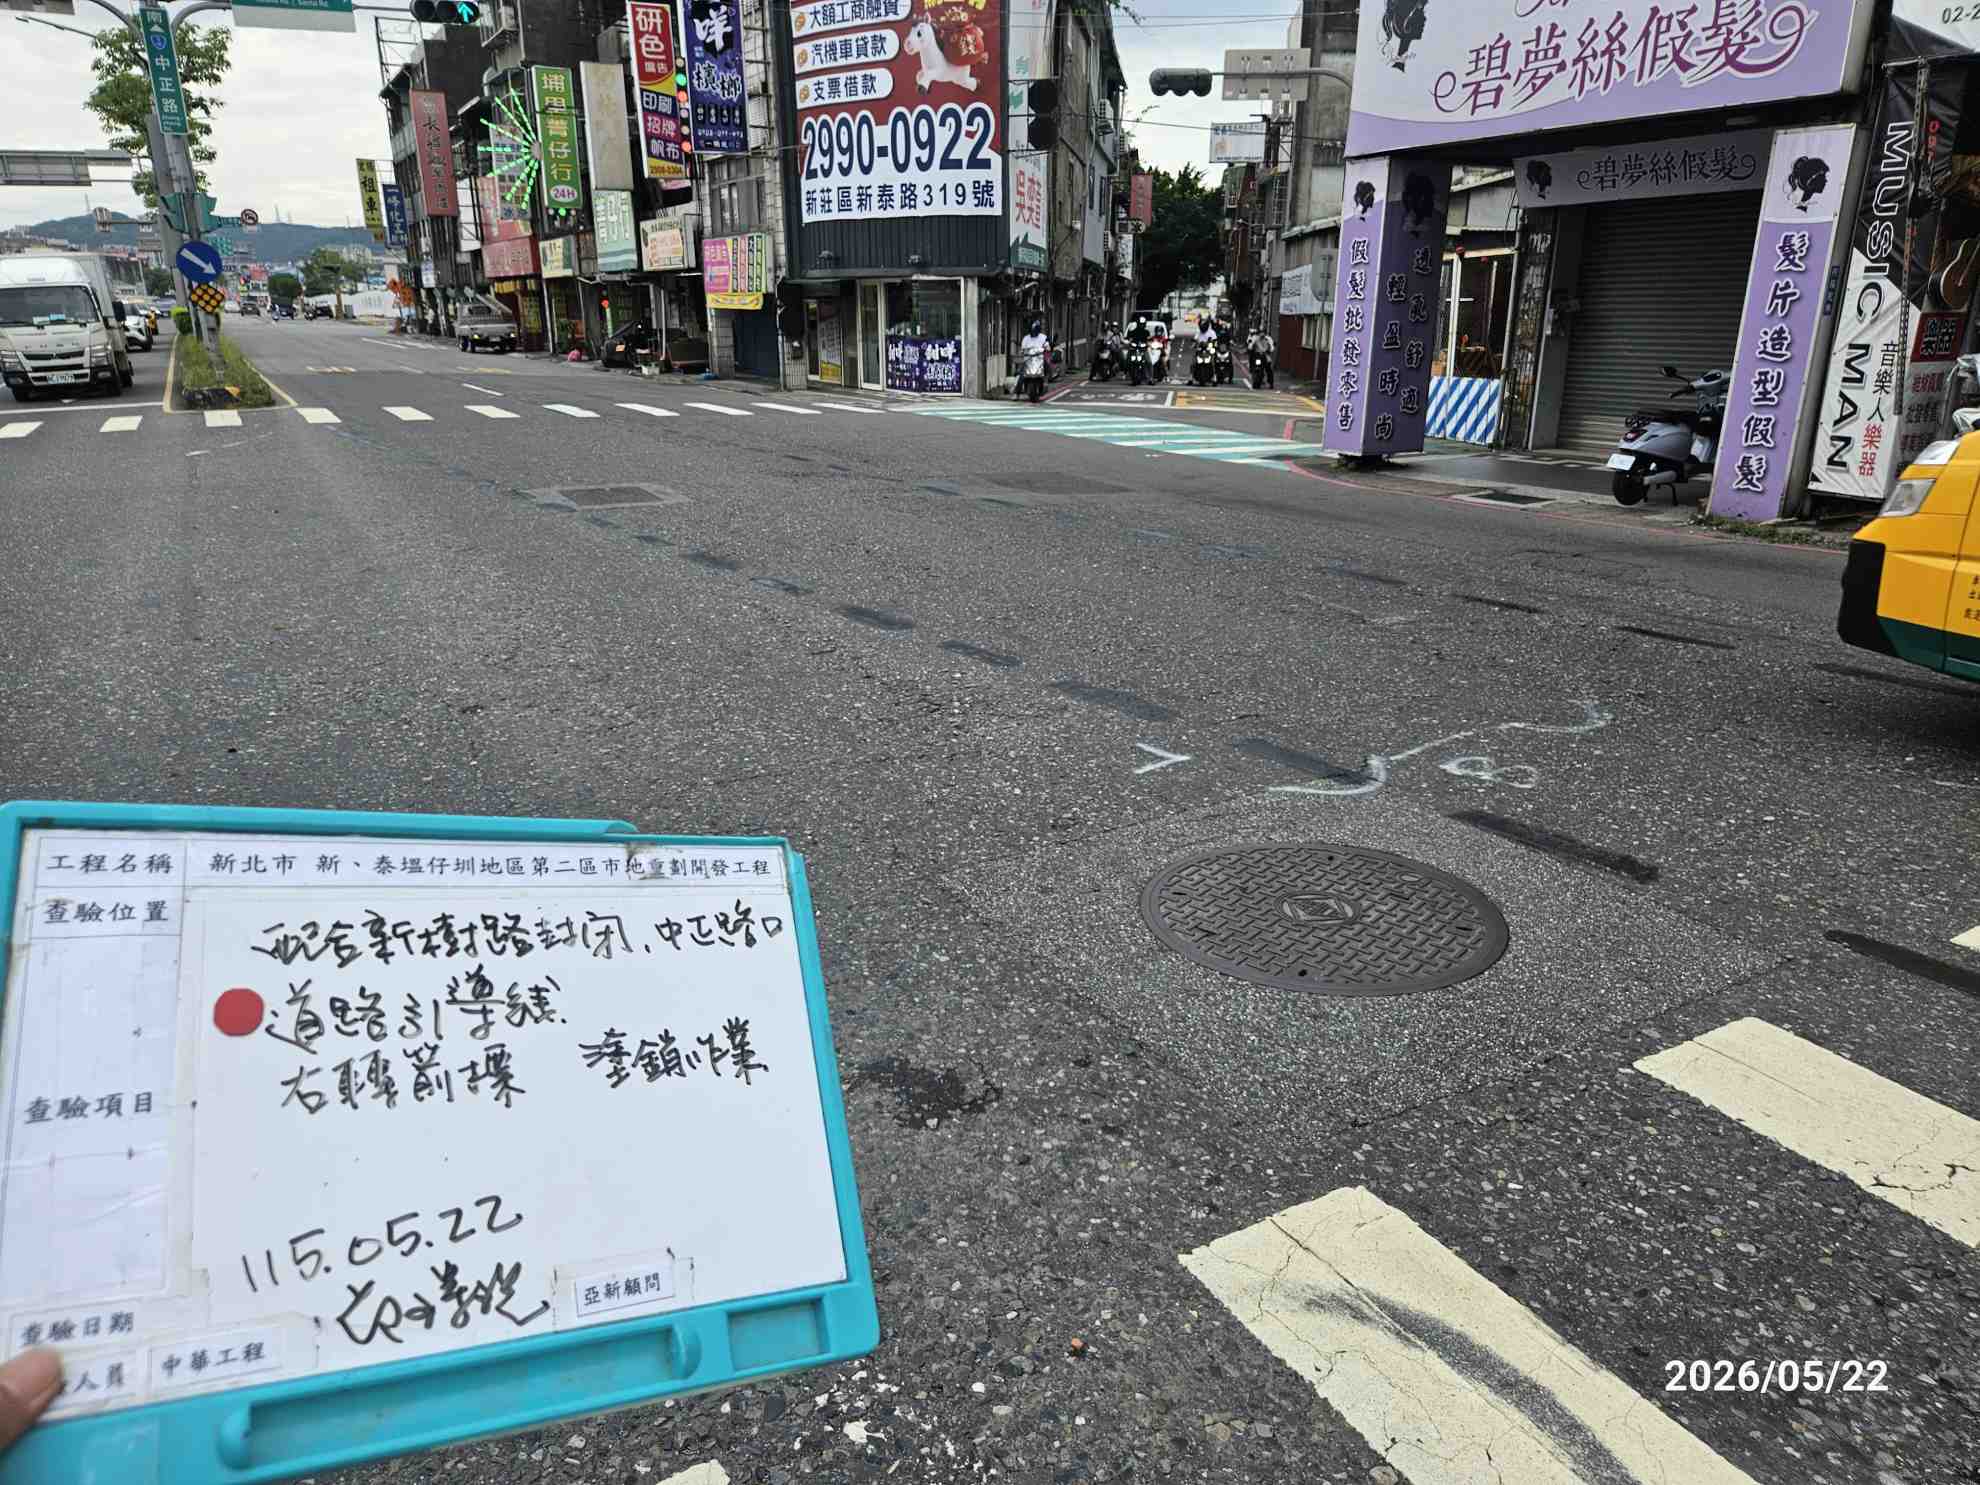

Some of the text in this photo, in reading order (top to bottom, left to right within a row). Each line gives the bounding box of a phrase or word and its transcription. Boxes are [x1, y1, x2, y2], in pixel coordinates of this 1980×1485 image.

[636, 7, 667, 60] 研色
[811, 34, 888, 66] 汽機車貸款
[1434, 0, 1806, 116] 碧夢絲假髮
[154, 54, 178, 113] 中正路
[641, 90, 672, 114] 印刷
[813, 76, 878, 102] 支票借款
[650, 138, 681, 160] 帆布
[804, 105, 992, 180] 2990-0922
[1576, 144, 1757, 193] 碧夢絲假髮
[805, 179, 995, 216] 新莊區新泰路319號
[1825, 121, 1914, 469] MUSIC MAN
[1337, 238, 1370, 431] 假髮批發零售
[1733, 231, 1811, 493] 髮片造型假髮
[1856, 340, 1899, 477] 音樂人 樂器
[47, 852, 174, 875] 工程名稱
[208, 852, 298, 875] 新北市
[43, 900, 169, 925] 查驗位置
[23, 1091, 153, 1125] 查驗項目
[241, 1194, 524, 1293] 115.05.22
[583, 1271, 662, 1307] 亞新顧問
[21, 1311, 135, 1347] 查驗日期
[161, 1341, 265, 1378] 中華工程
